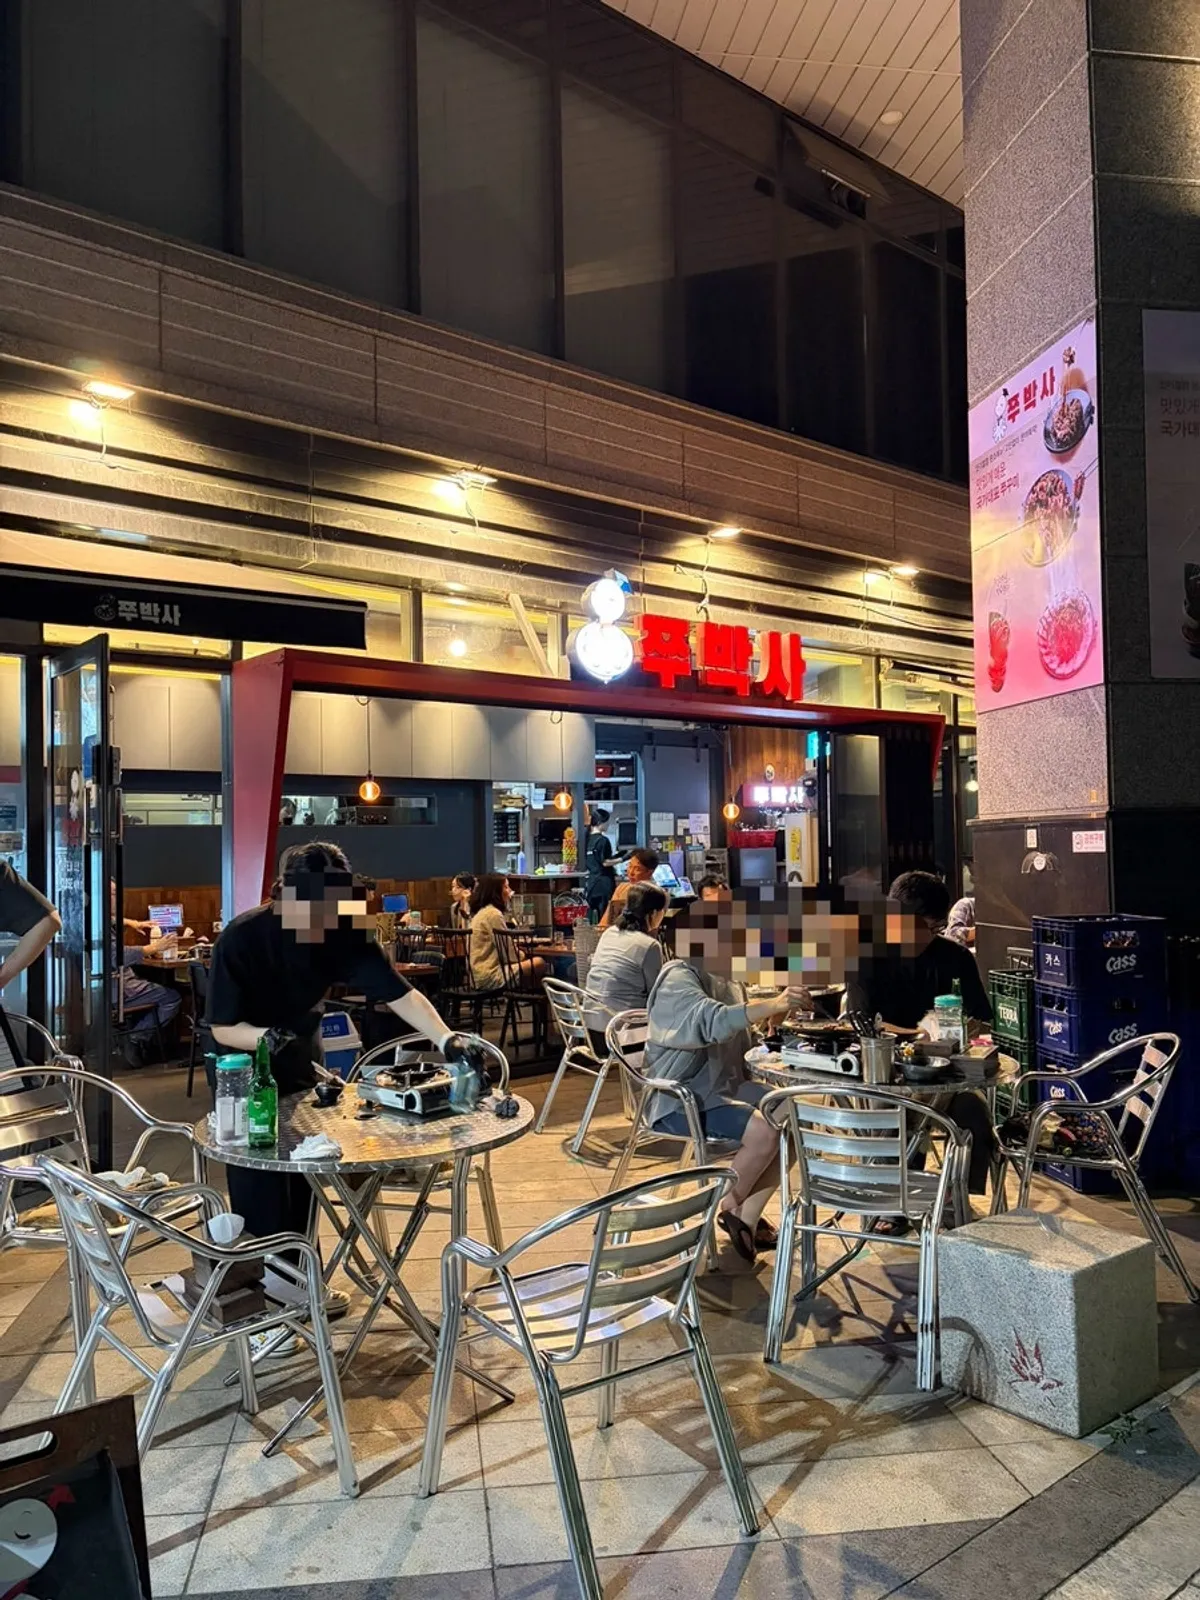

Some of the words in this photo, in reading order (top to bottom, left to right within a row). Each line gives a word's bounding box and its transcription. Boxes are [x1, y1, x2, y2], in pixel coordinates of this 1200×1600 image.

[117, 600, 181, 626] 쭈박사
[636, 613, 806, 703] 쭈박사
[1045, 953, 1060, 966] 카스
[999, 1005, 1019, 1023] TERRA
